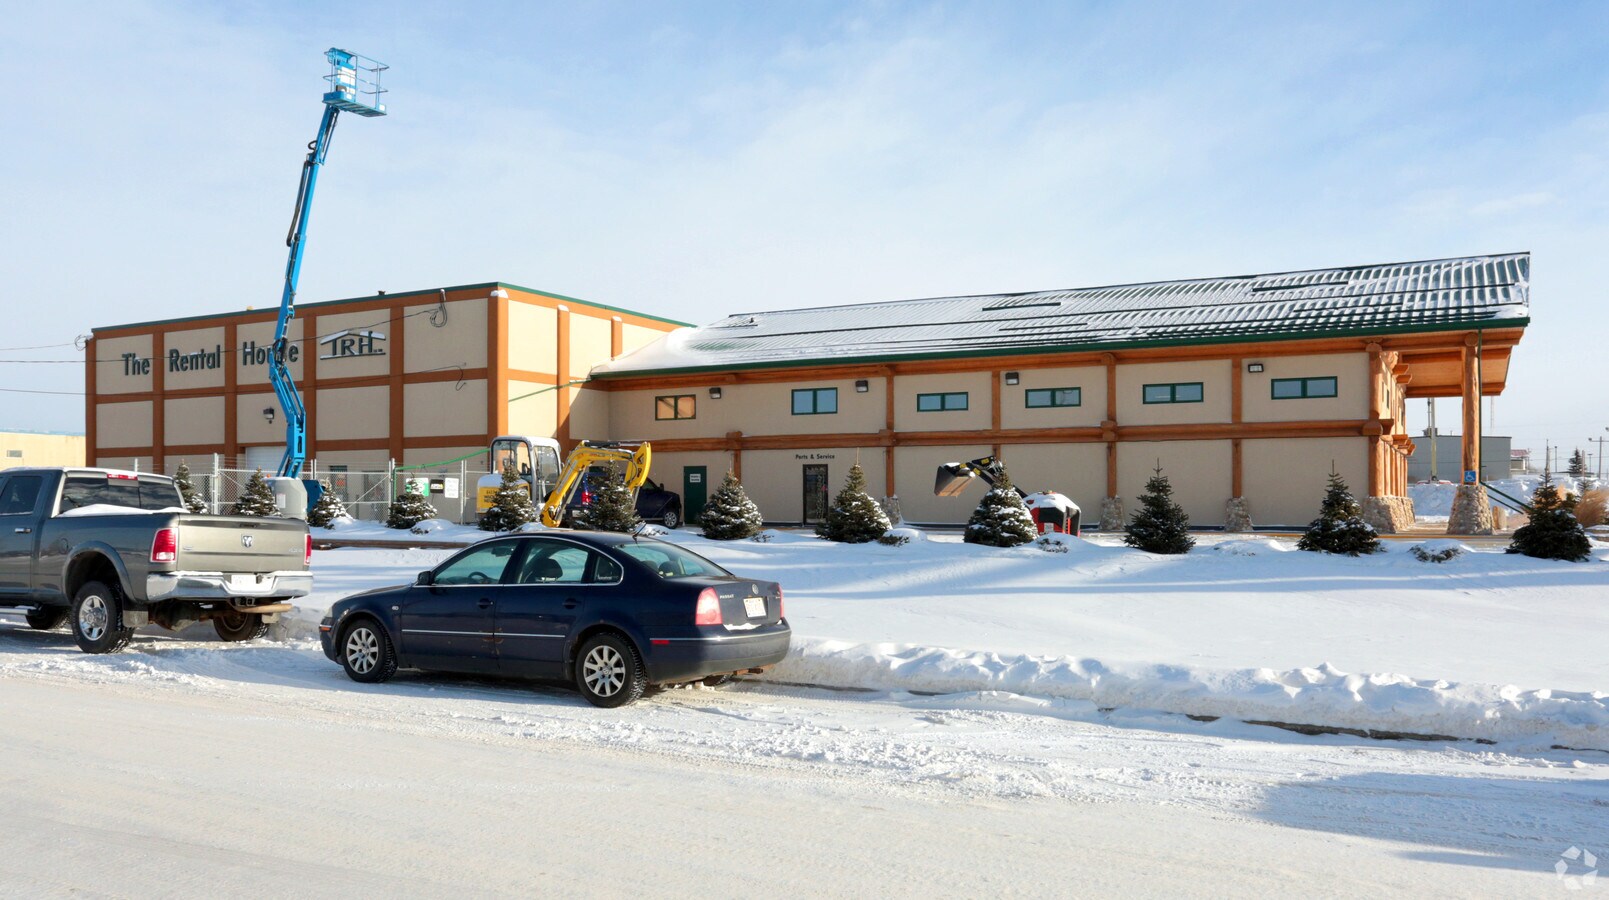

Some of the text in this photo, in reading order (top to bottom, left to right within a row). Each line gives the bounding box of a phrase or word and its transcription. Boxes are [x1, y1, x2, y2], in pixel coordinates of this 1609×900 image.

[122, 341, 299, 376] The Rental Hoe
